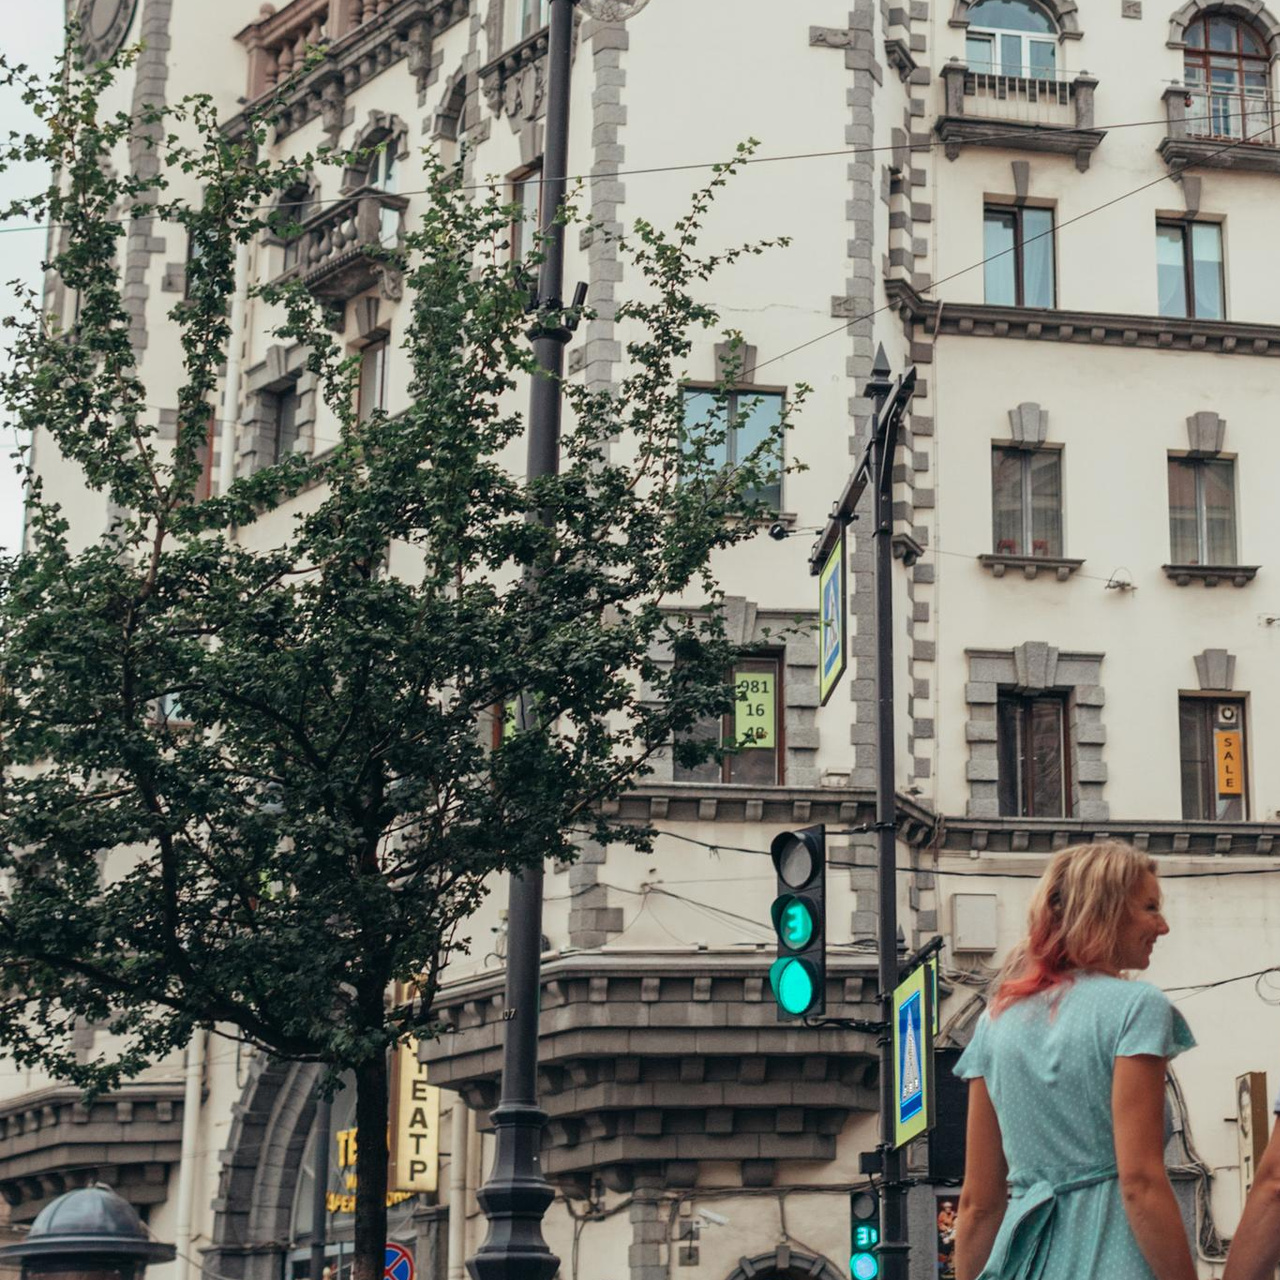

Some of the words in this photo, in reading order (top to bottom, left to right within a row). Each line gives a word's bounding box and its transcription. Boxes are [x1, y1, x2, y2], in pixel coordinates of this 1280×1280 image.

[741, 680, 769, 694] 981
[746, 704, 765, 717] 16
[1223, 737, 1234, 788] SALE
